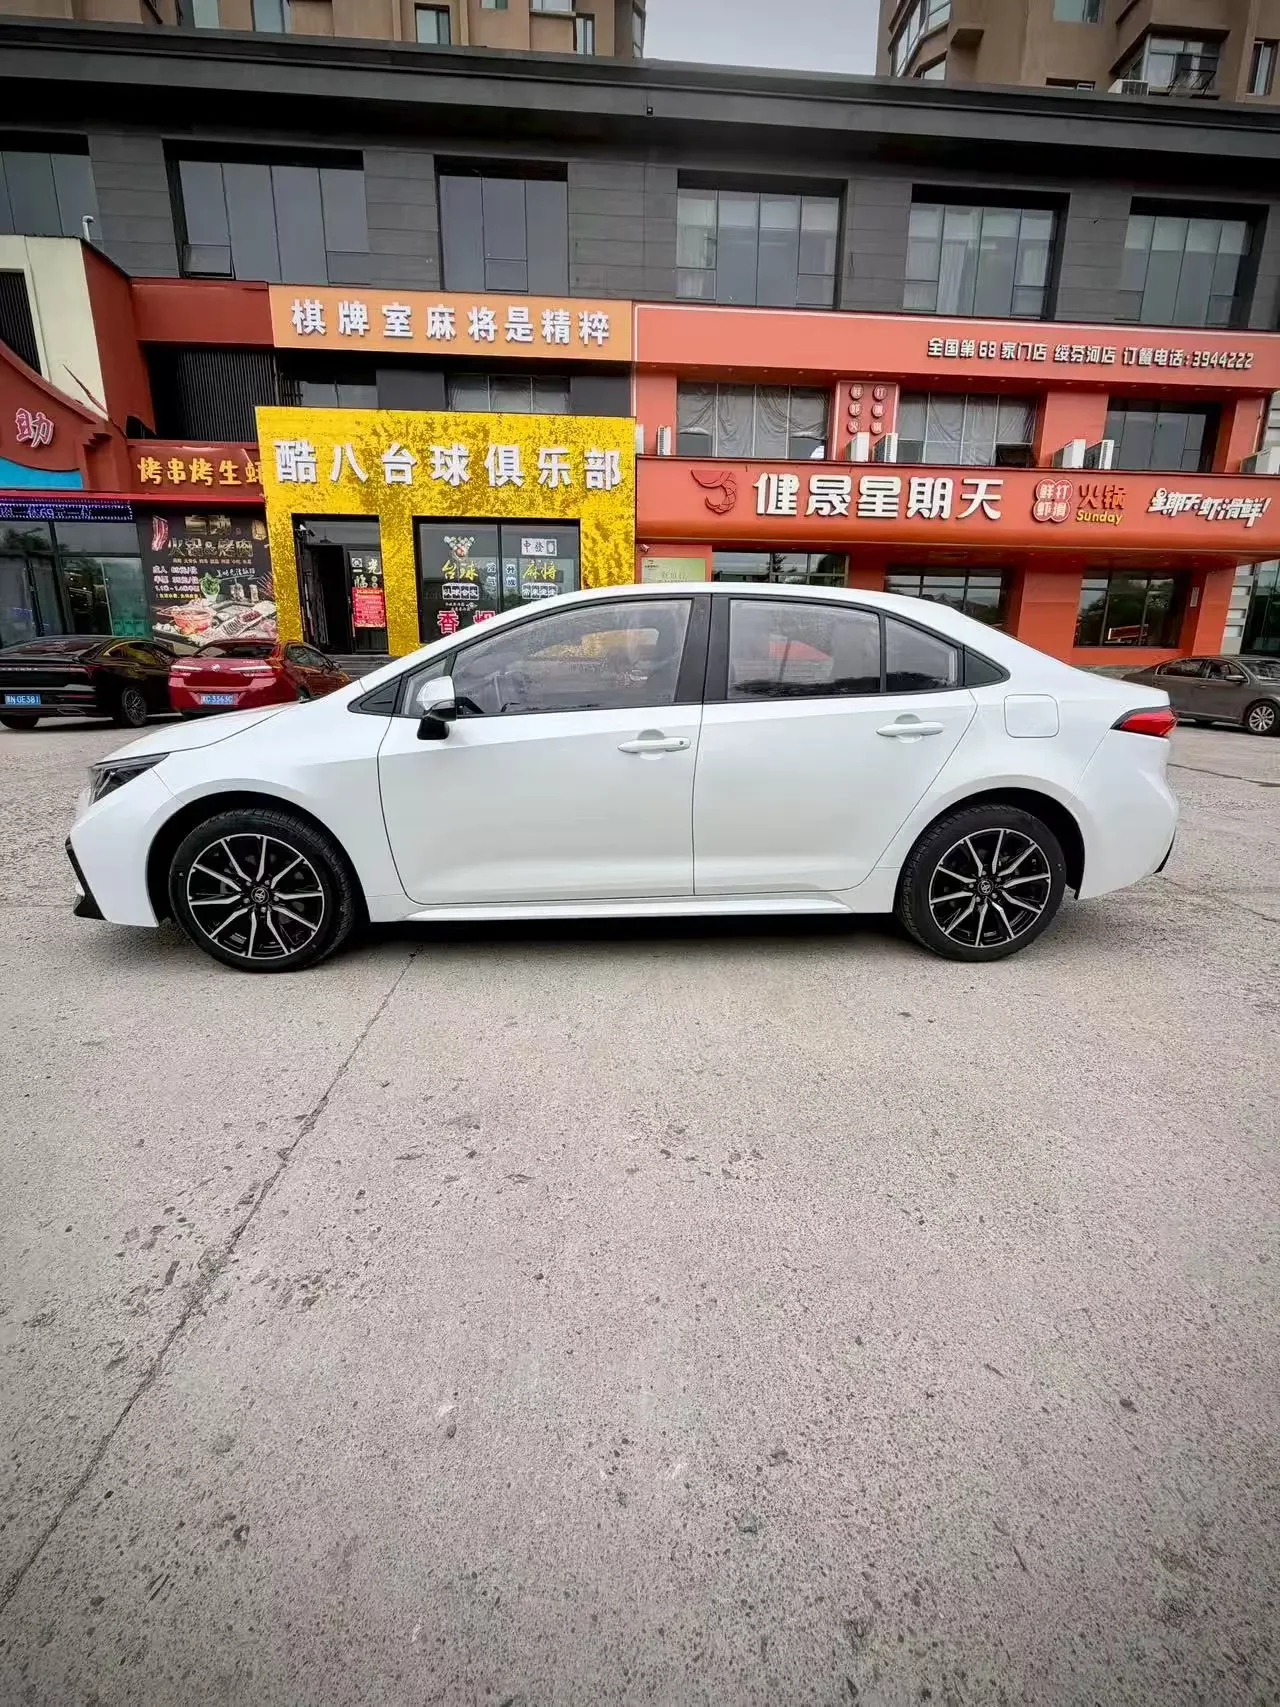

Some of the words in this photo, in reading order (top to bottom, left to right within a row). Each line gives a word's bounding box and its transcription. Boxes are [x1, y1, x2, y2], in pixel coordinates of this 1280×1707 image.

[291, 298, 610, 346] 棋牌室麻将是精粹
[1054, 343, 1116, 366] 绥芬河店
[273, 438, 623, 491] 酷八台球俱乐部
[752, 471, 1004, 520] 健晟星期天
[1076, 510, 1124, 526] Sunday
